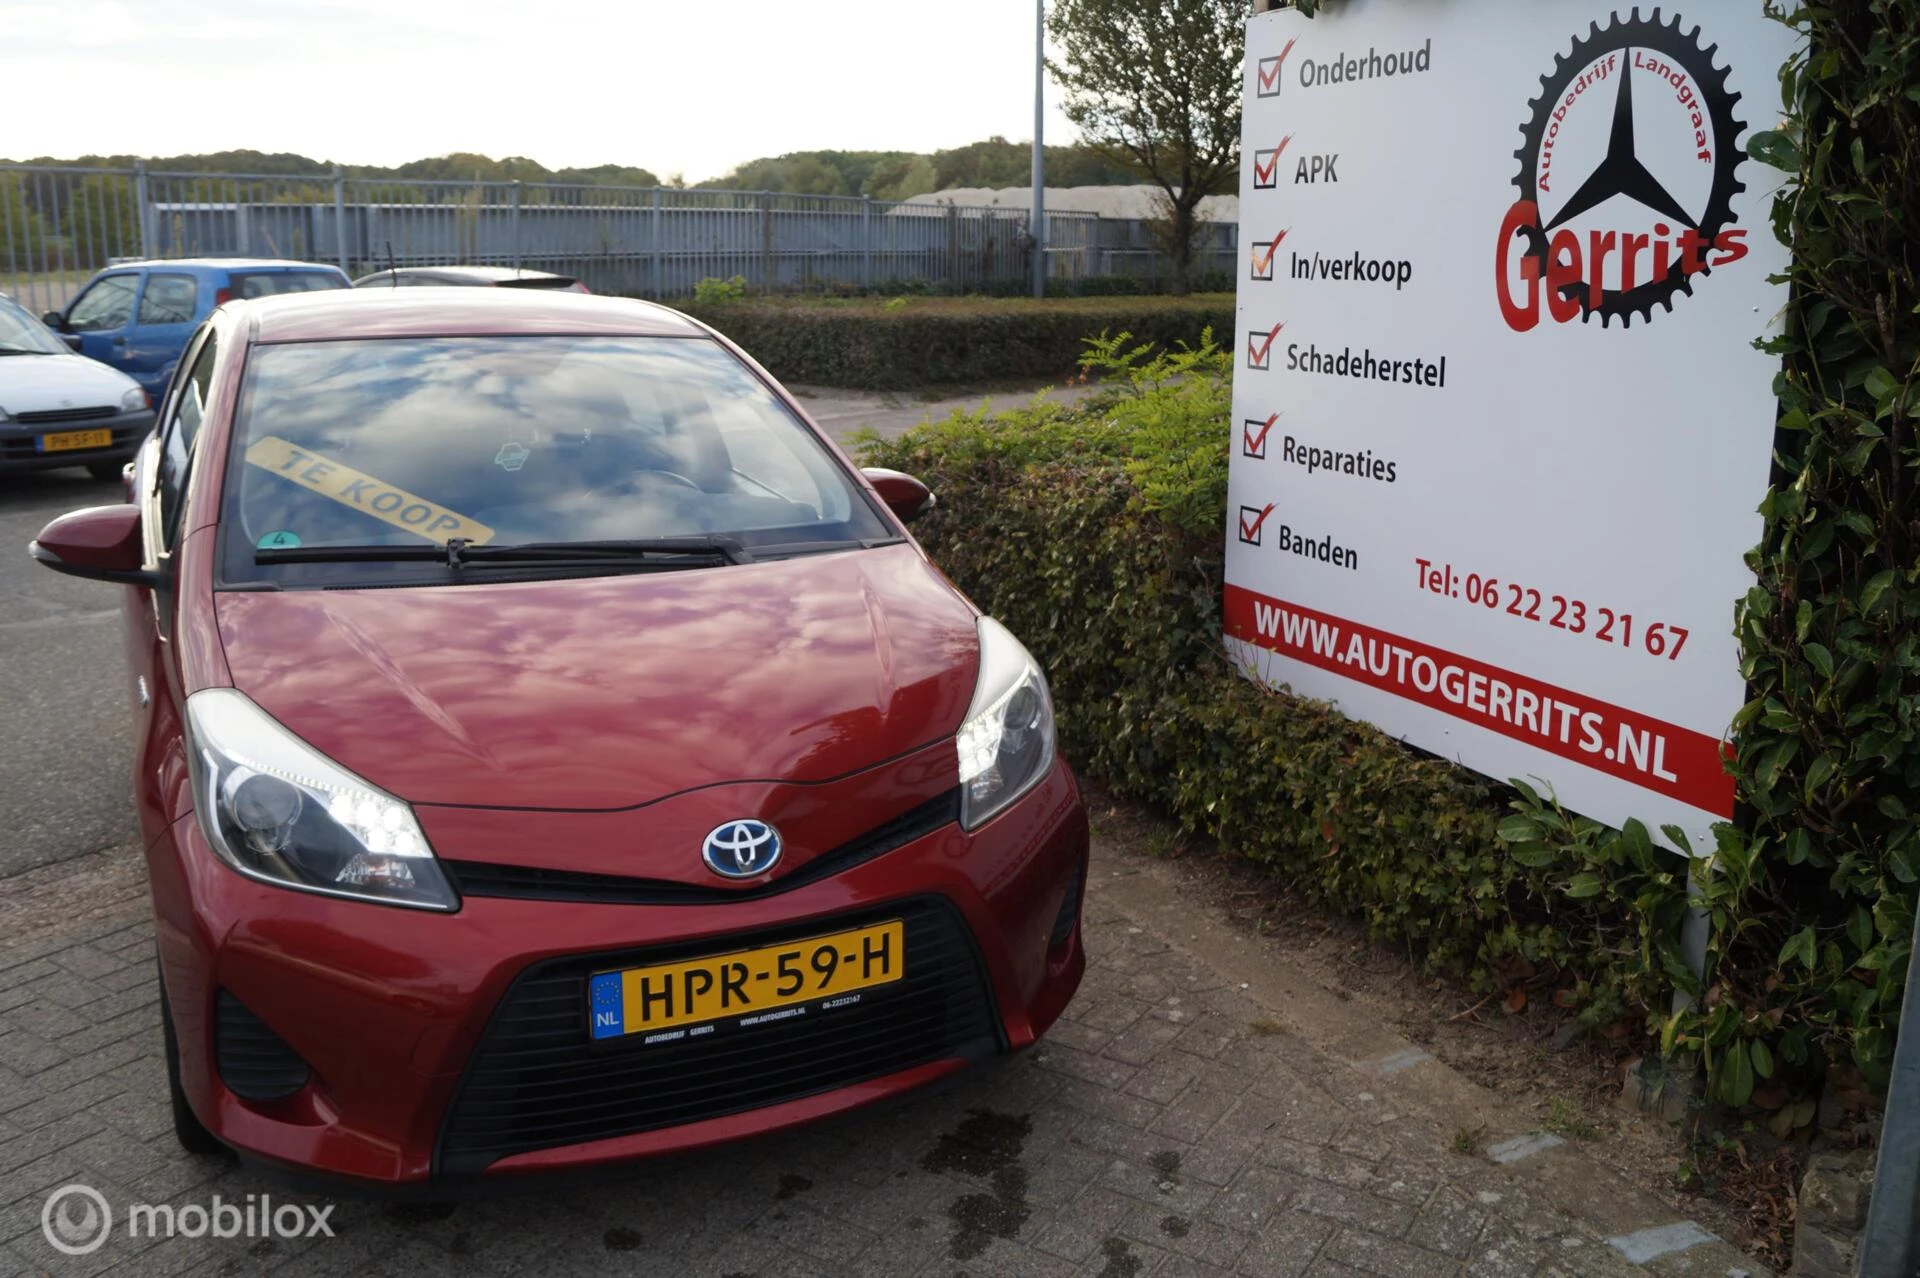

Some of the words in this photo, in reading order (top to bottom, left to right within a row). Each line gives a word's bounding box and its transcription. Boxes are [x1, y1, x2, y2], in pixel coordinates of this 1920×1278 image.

[1299, 38, 1432, 89] Onderhoud
[1538, 54, 1618, 193] Autobedrijf
[1634, 51, 1712, 165] Landgraaf
[1294, 153, 1339, 185] APK
[1290, 251, 1413, 291] In/verkoop
[1495, 200, 1750, 333] Gerrits
[1286, 342, 1446, 389] Schadeherstel
[1283, 435, 1397, 484] Reparaties
[279, 449, 337, 485] TE
[338, 478, 462, 534] KOOP
[273, 533, 285, 544] 4
[1279, 524, 1358, 570] Banden
[1415, 557, 1459, 599] Tel:
[1465, 573, 1500, 609] 06
[1506, 583, 1542, 622] 22
[1549, 595, 1587, 634] 23
[1595, 607, 1633, 648] 21
[1645, 622, 1690, 662] 67
[1253, 600, 1678, 783] WWW.AUTOGERRITS.NL
[640, 931, 891, 1023] HPR-59-H
[596, 1011, 620, 1028] NL
